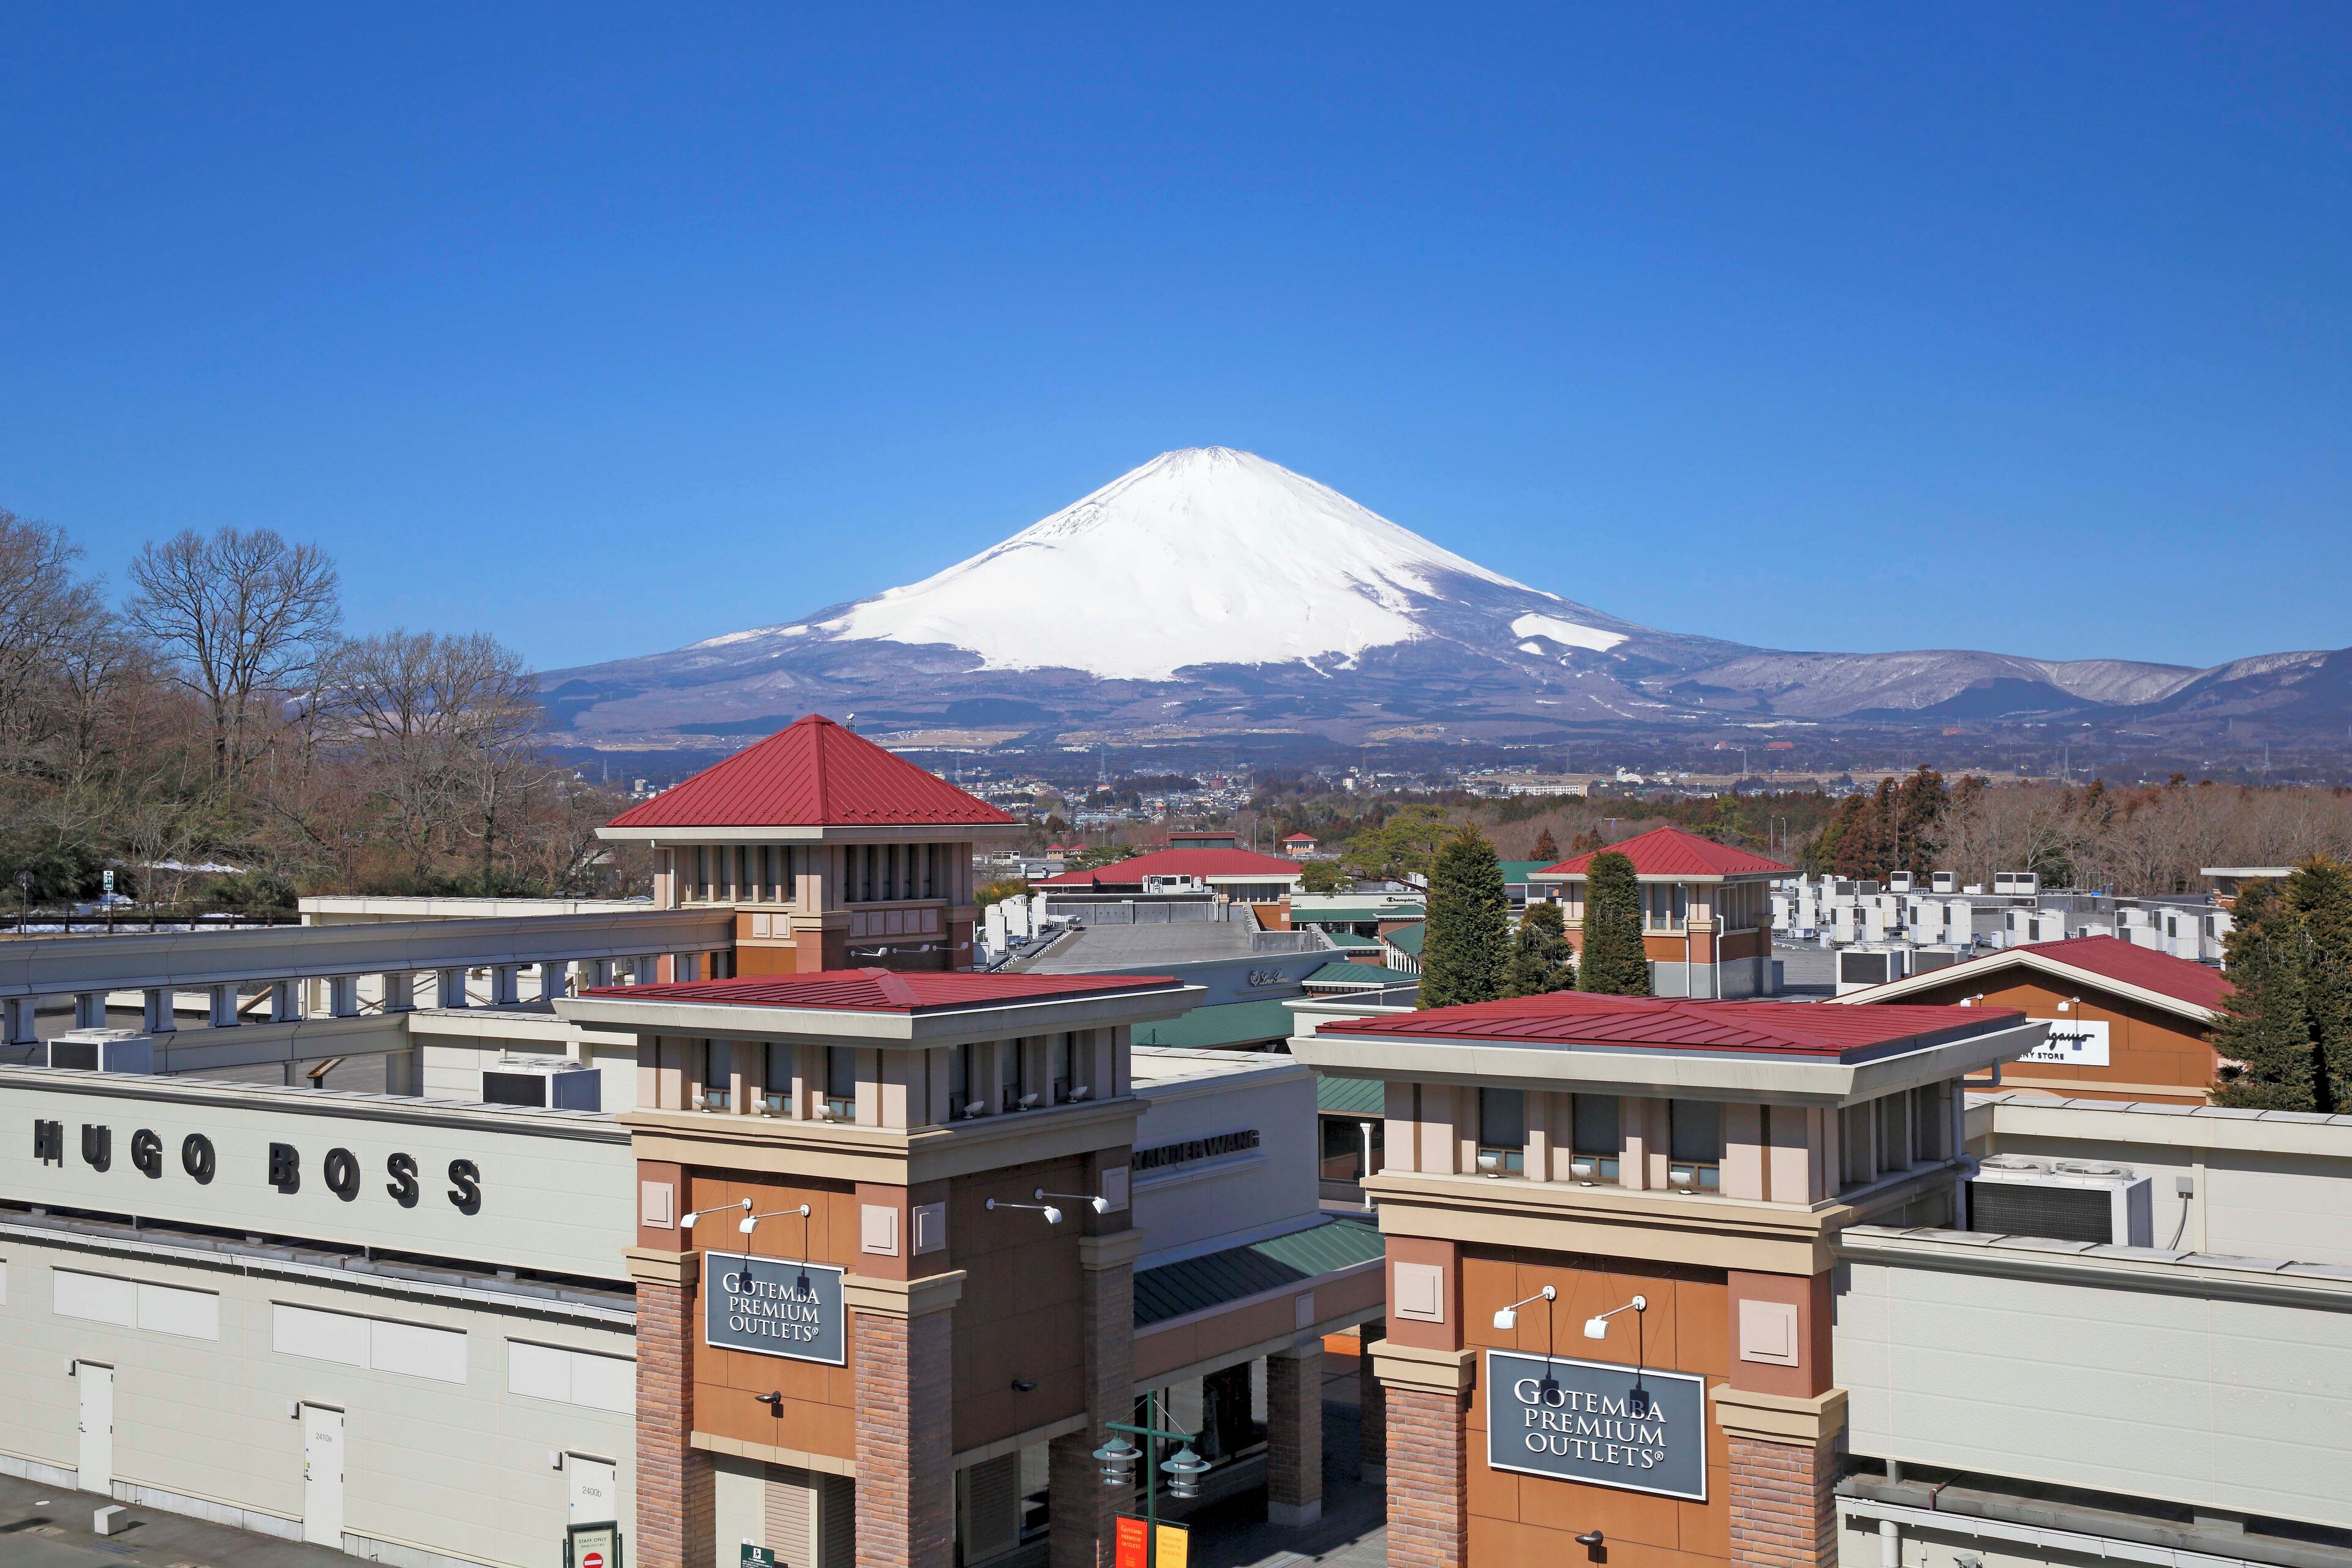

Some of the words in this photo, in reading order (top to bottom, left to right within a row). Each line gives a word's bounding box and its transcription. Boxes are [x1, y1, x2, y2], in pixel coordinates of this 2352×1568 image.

[1205, 1130, 1259, 1156] WANG
[34, 1119, 214, 1181] HUGO
[268, 1142, 480, 1209] BOSS
[723, 1273, 821, 1305] GOTEMBA
[729, 1296, 821, 1324] PREMIUM
[1514, 1379, 1667, 1423] GOTEMBA
[315, 1432, 332, 1442] 2410a
[1524, 1408, 1667, 1447] PREMIUM
[582, 1486, 601, 1497] 2400b
[1121, 1526, 1142, 1535] GOTEMBA
